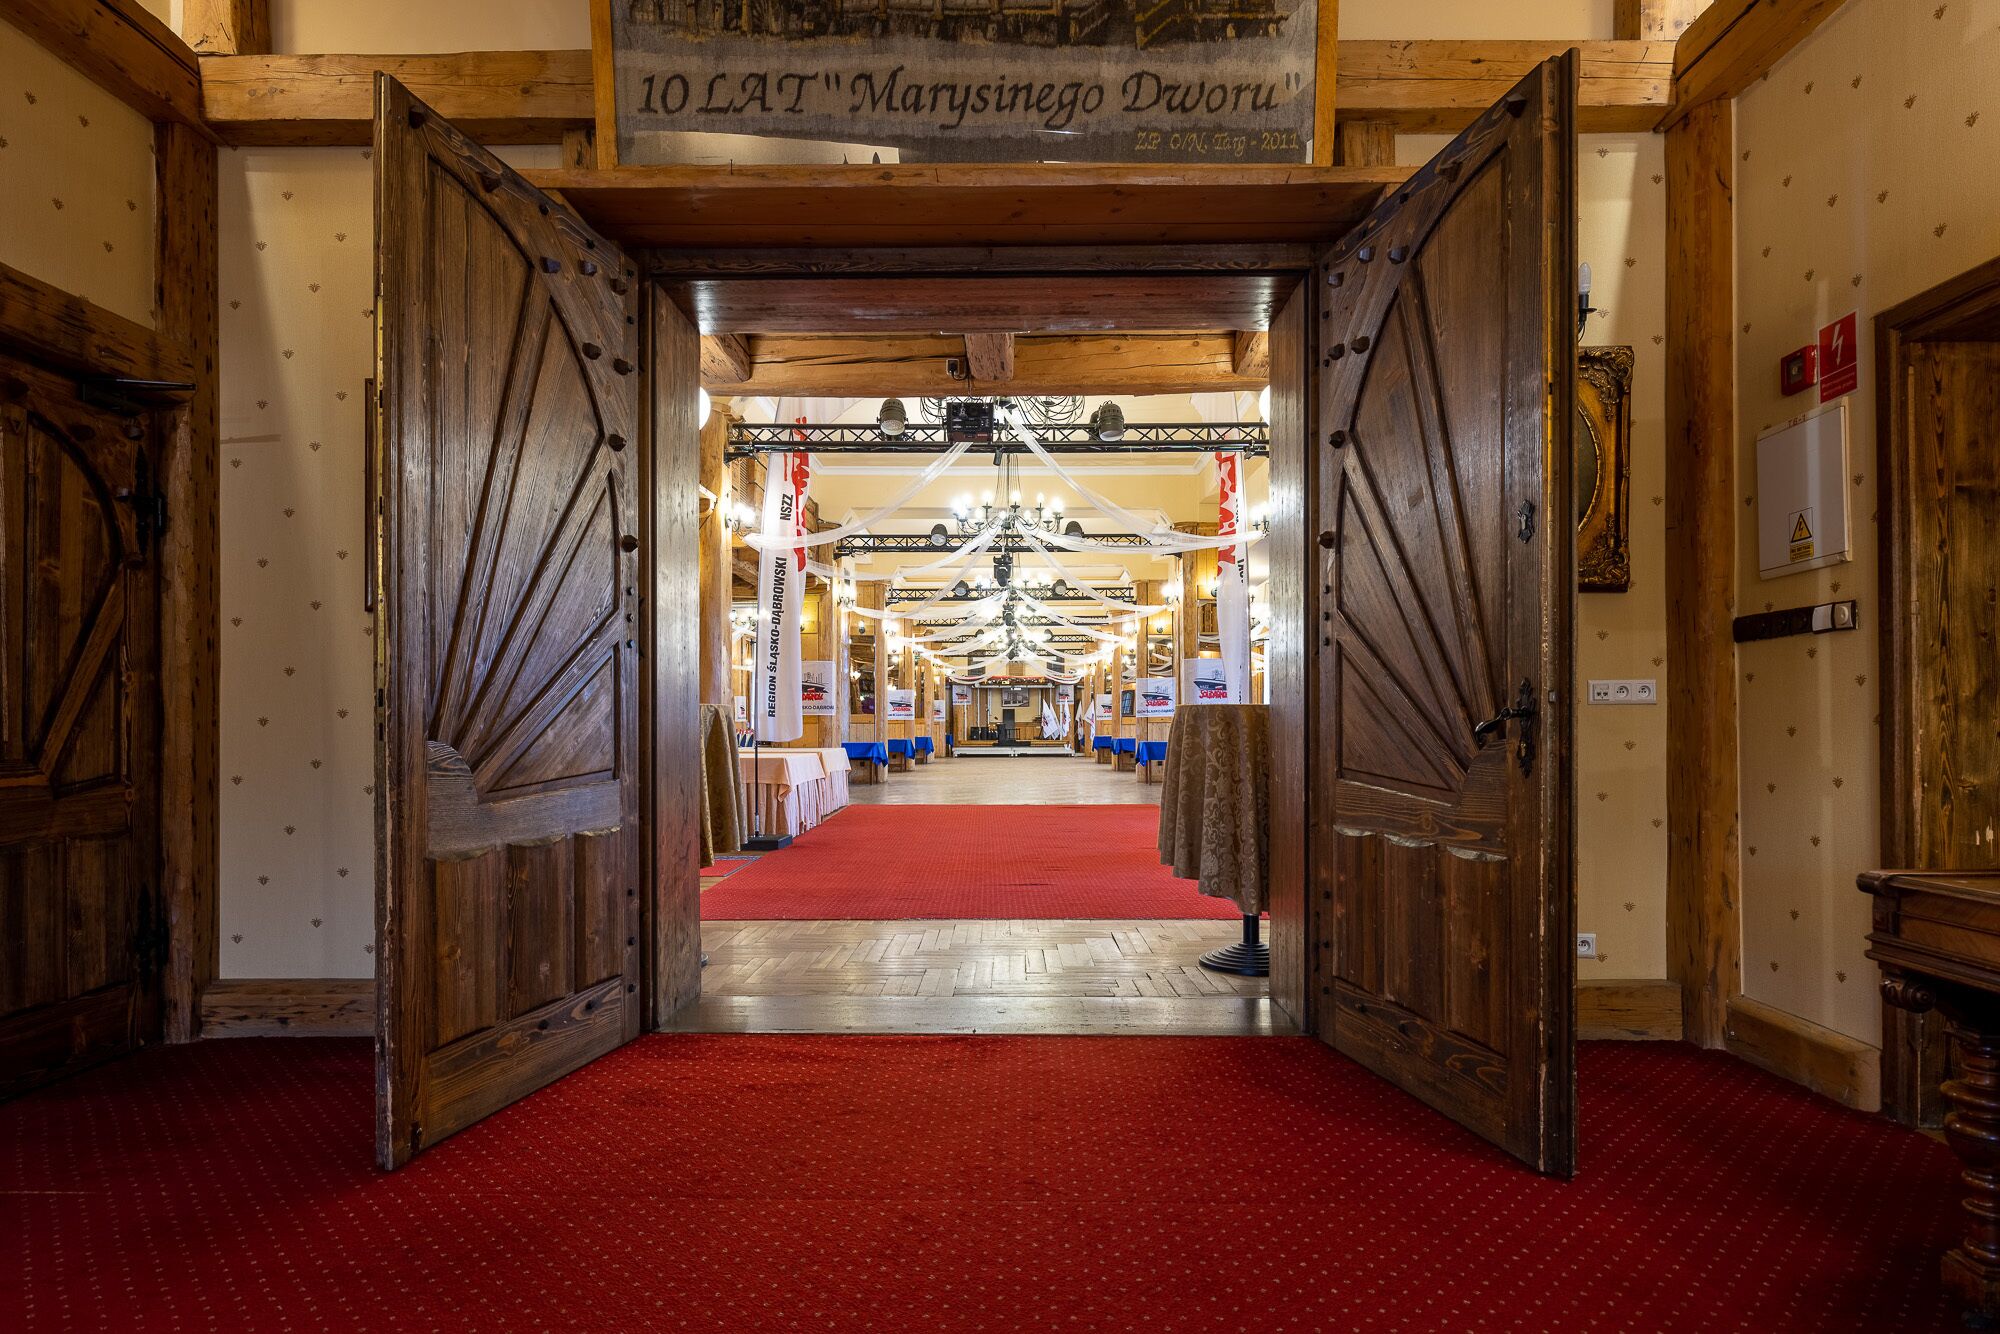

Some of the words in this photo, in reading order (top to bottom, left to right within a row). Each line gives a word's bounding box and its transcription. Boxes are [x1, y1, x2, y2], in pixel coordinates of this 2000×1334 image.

[638, 73, 690, 114] 10
[696, 73, 819, 114] LAT
[825, 65, 1105, 129] "Marysinego
[1120, 69, 1301, 113] Dworu"
[1260, 131, 1299, 150] 2011
[779, 494, 795, 521] NSZZ
[766, 556, 789, 673] ŚLĄSKO-DĄBROWSKI
[767, 675, 778, 718] REGION
